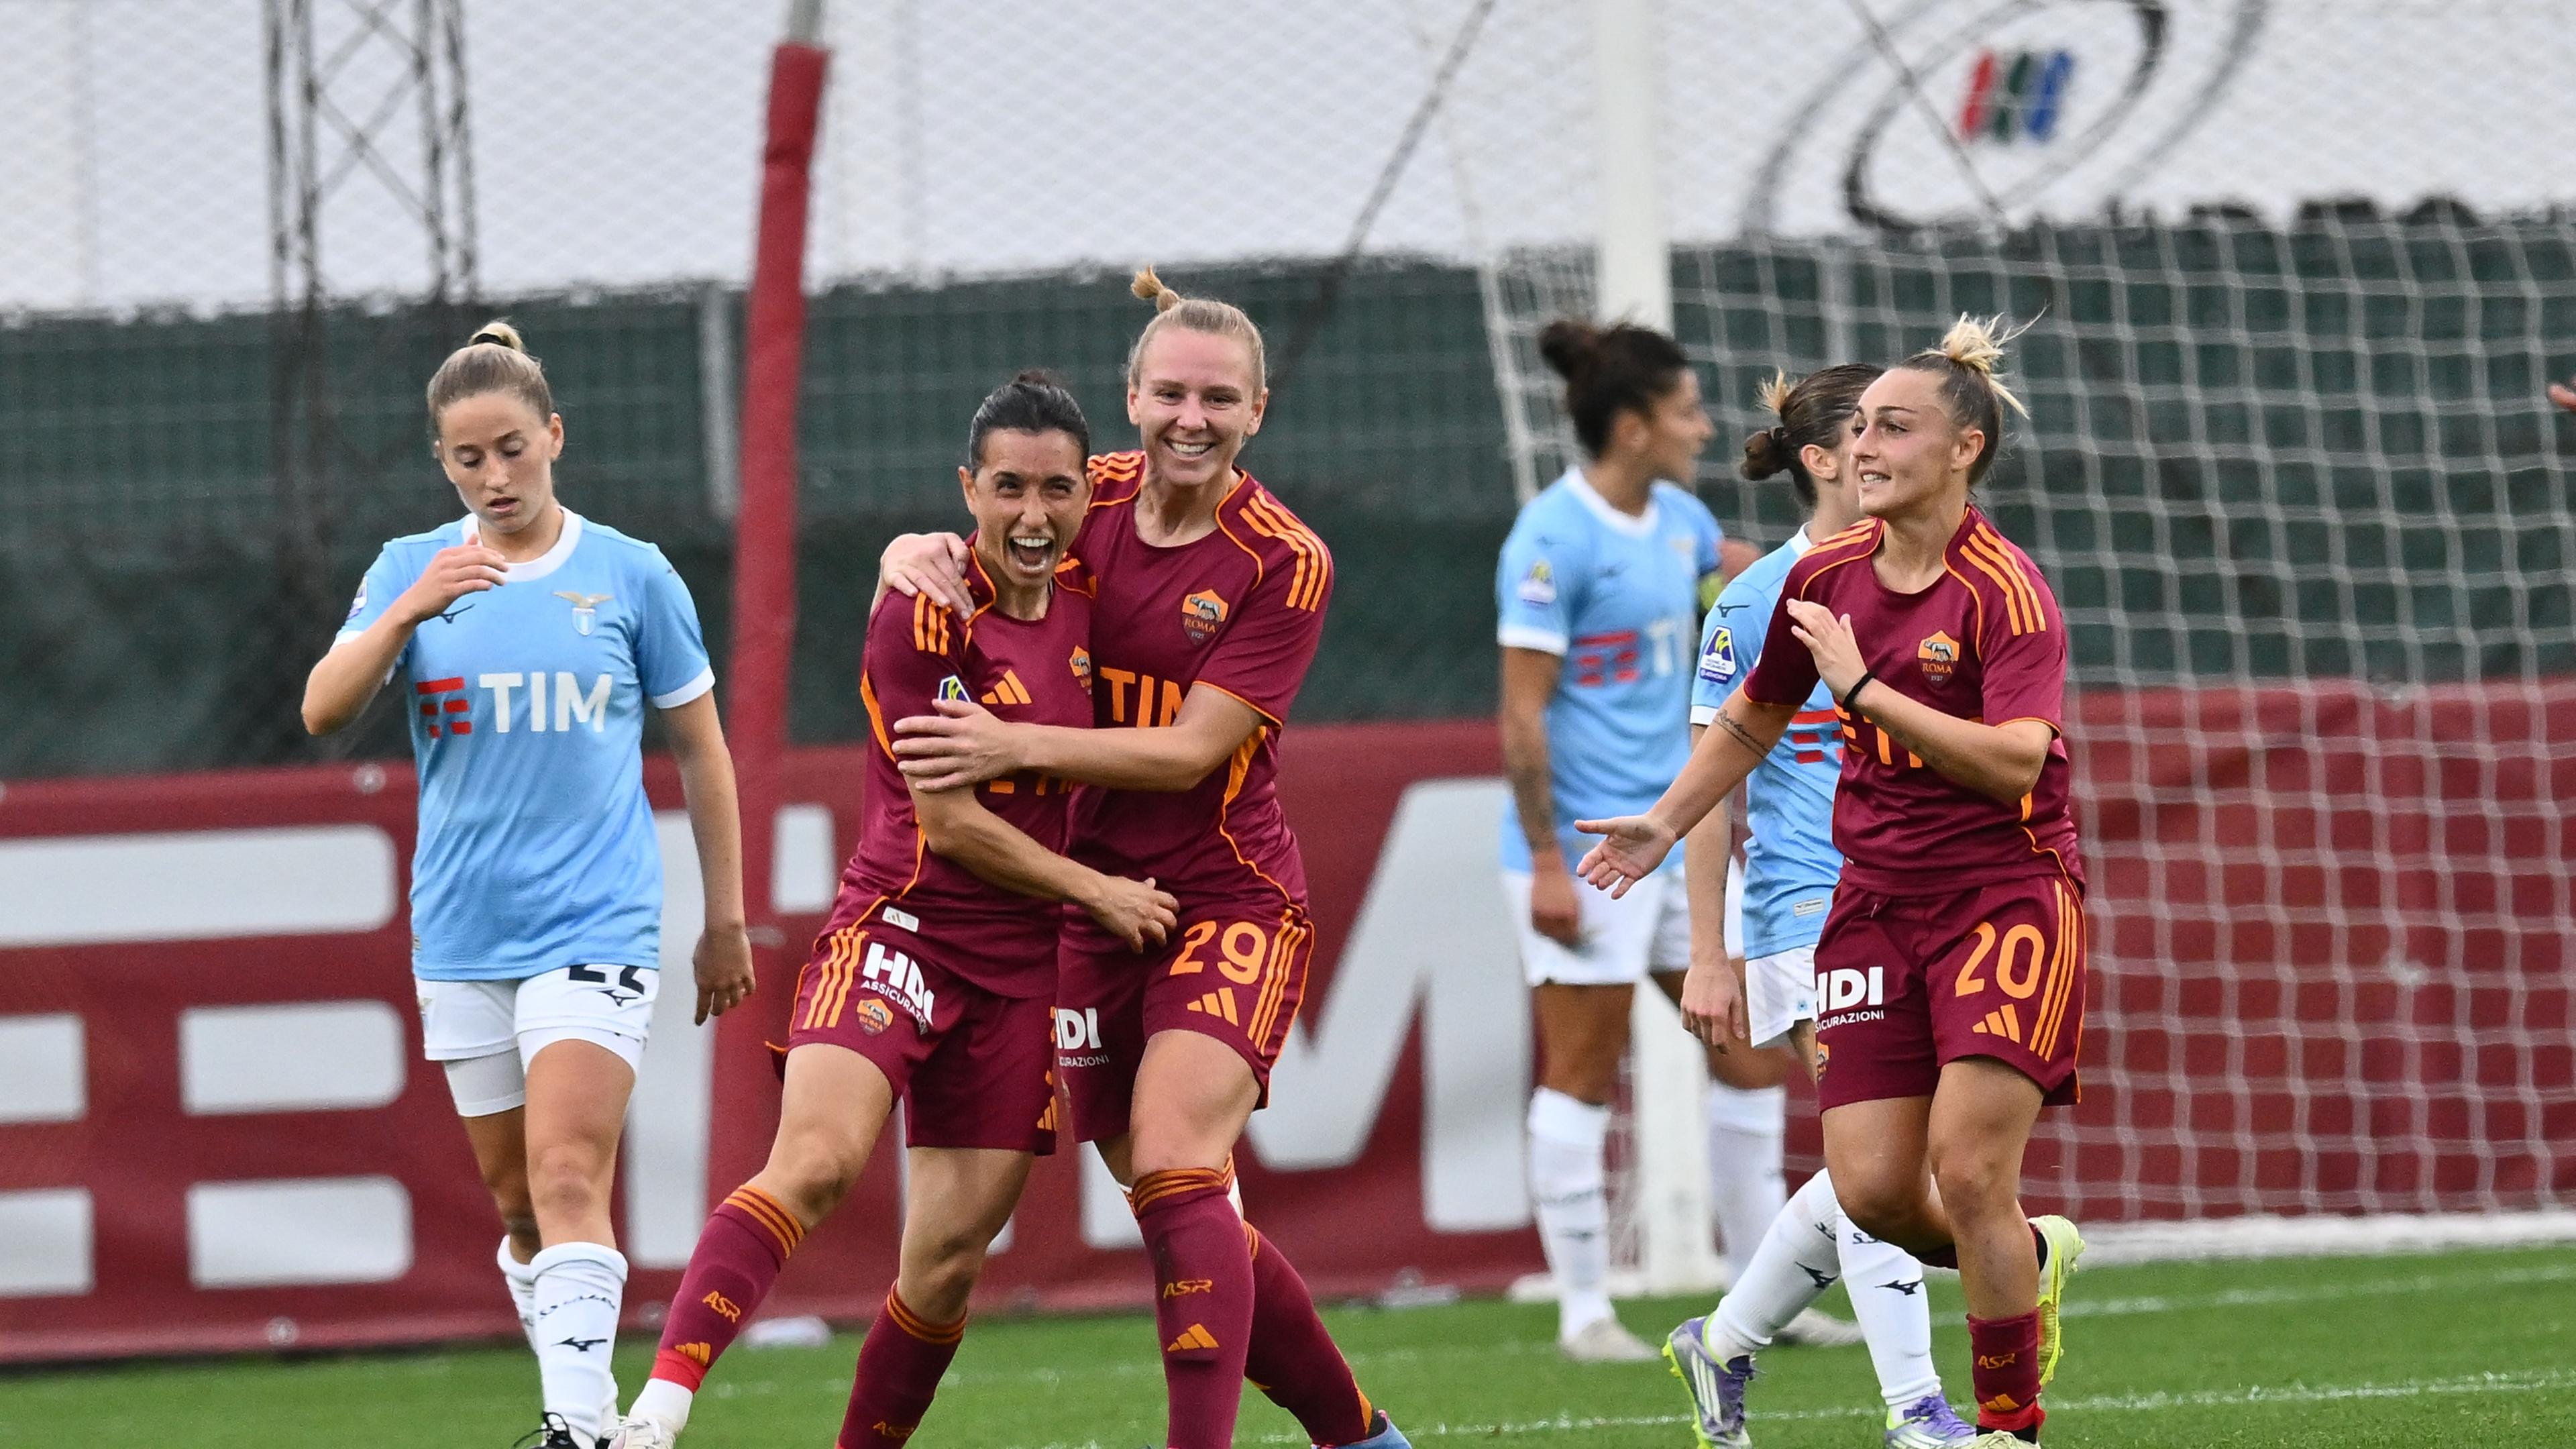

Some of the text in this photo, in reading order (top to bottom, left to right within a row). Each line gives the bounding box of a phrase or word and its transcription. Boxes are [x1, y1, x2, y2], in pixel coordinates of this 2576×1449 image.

[1184, 618, 1216, 633] ROMA
[1922, 663, 1953, 674] ROMA
[479, 672, 613, 733] TIM
[1169, 920, 1267, 985] 29
[1955, 922, 2045, 1000] 20
[863, 942, 935, 1026] HDI
[1055, 1008, 1102, 1050] DI
[1815, 1009, 1885, 1033] SICURAZIONI
[1163, 1279, 1213, 1299] ASR
[702, 1290, 741, 1324] ASR
[1978, 1352, 2015, 1369] ASR
